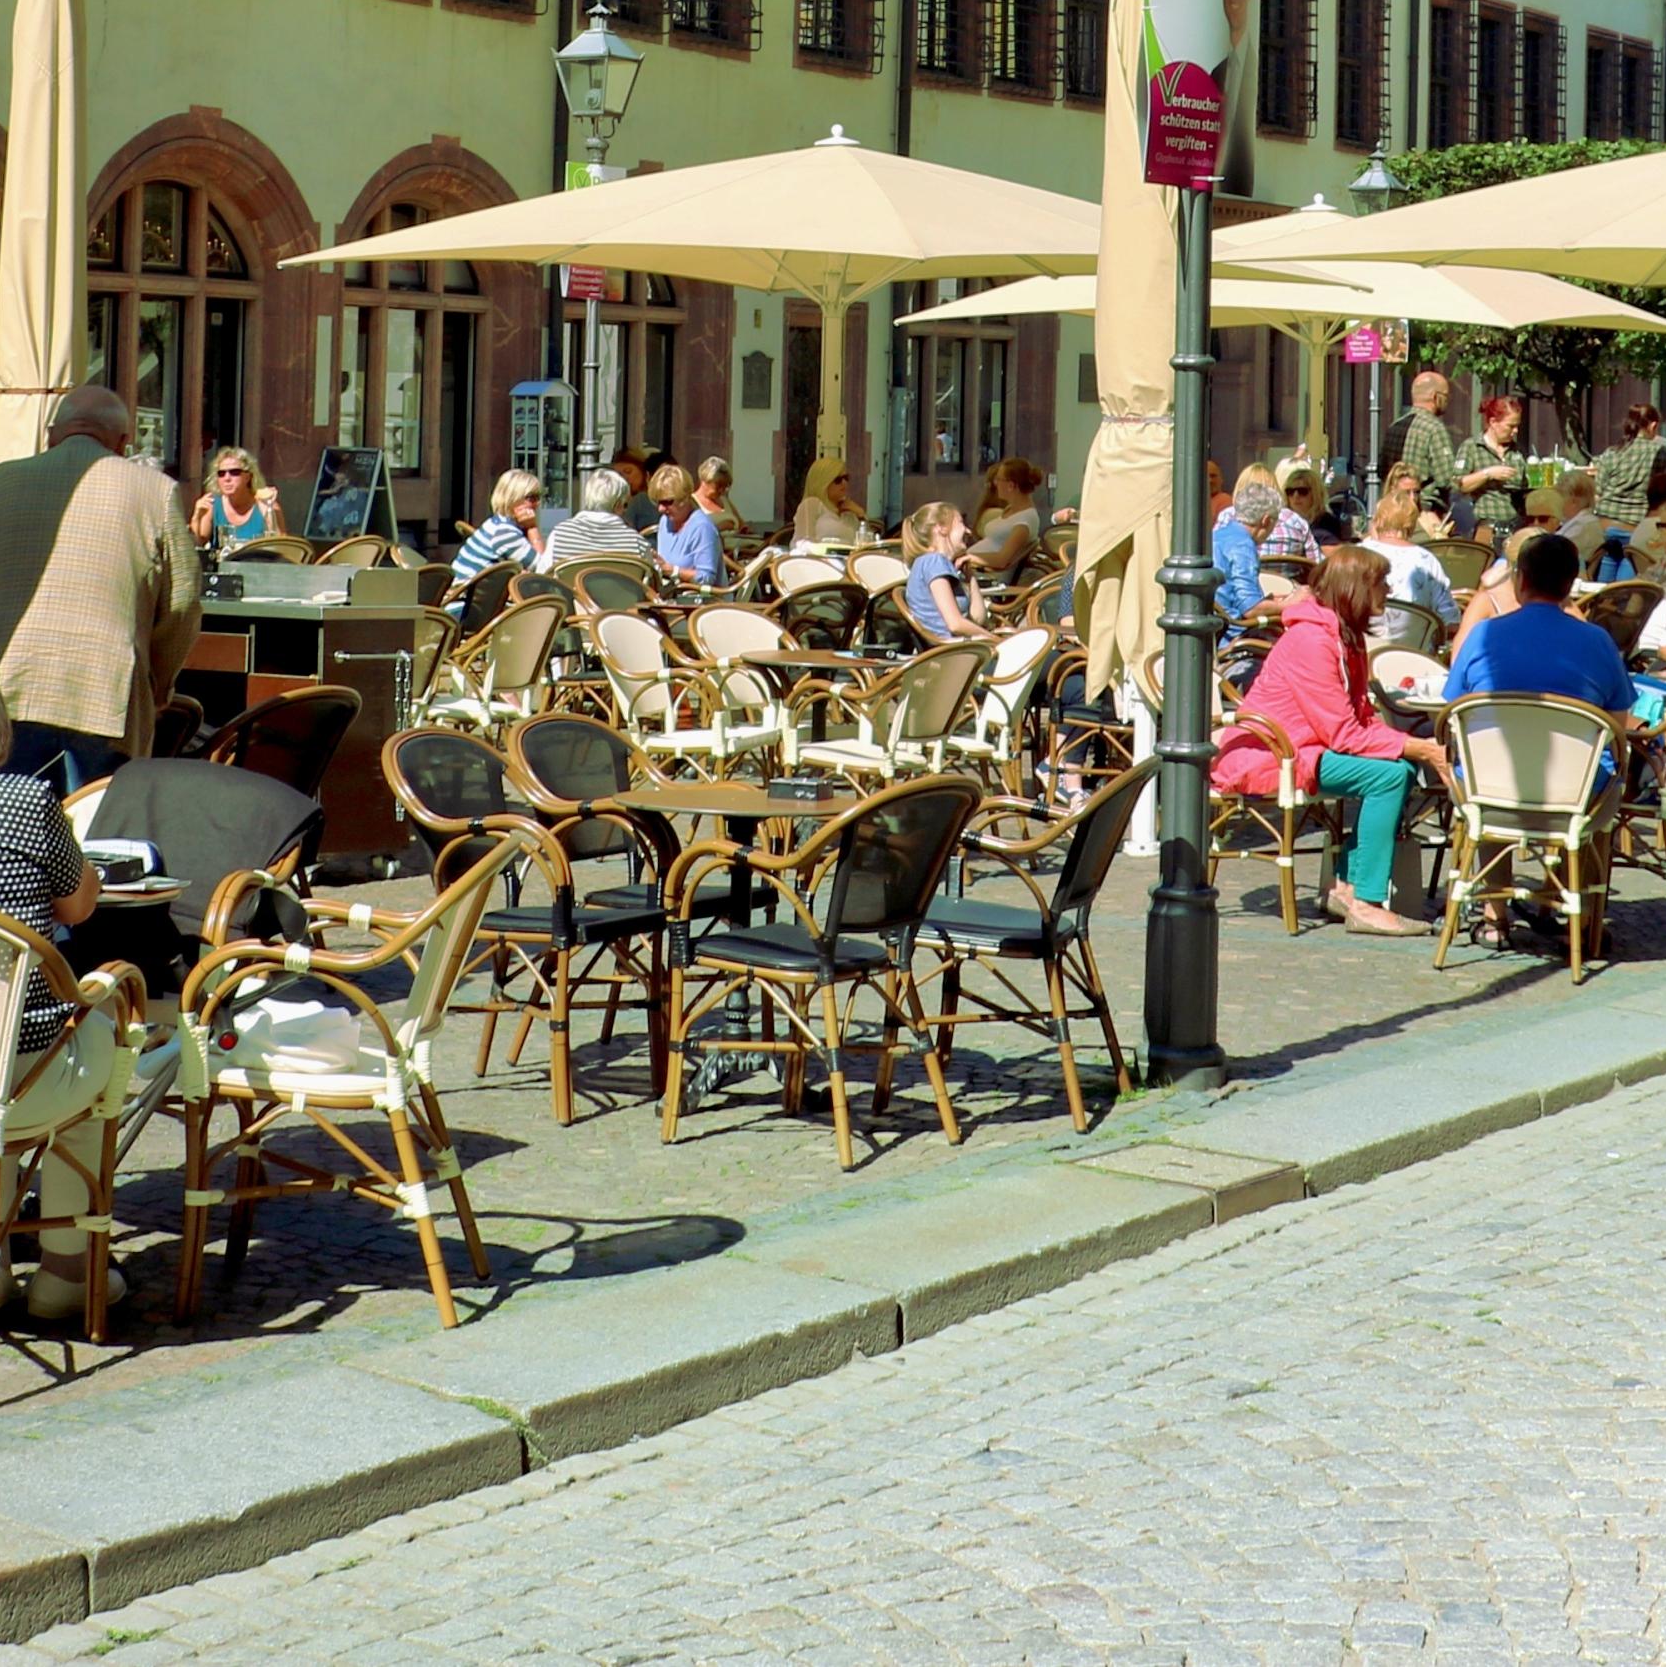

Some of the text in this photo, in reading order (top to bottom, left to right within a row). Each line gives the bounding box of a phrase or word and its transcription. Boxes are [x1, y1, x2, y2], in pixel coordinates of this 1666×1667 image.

[1160, 112, 1221, 134] schützen statt
[1165, 134, 1207, 152] vergiften
